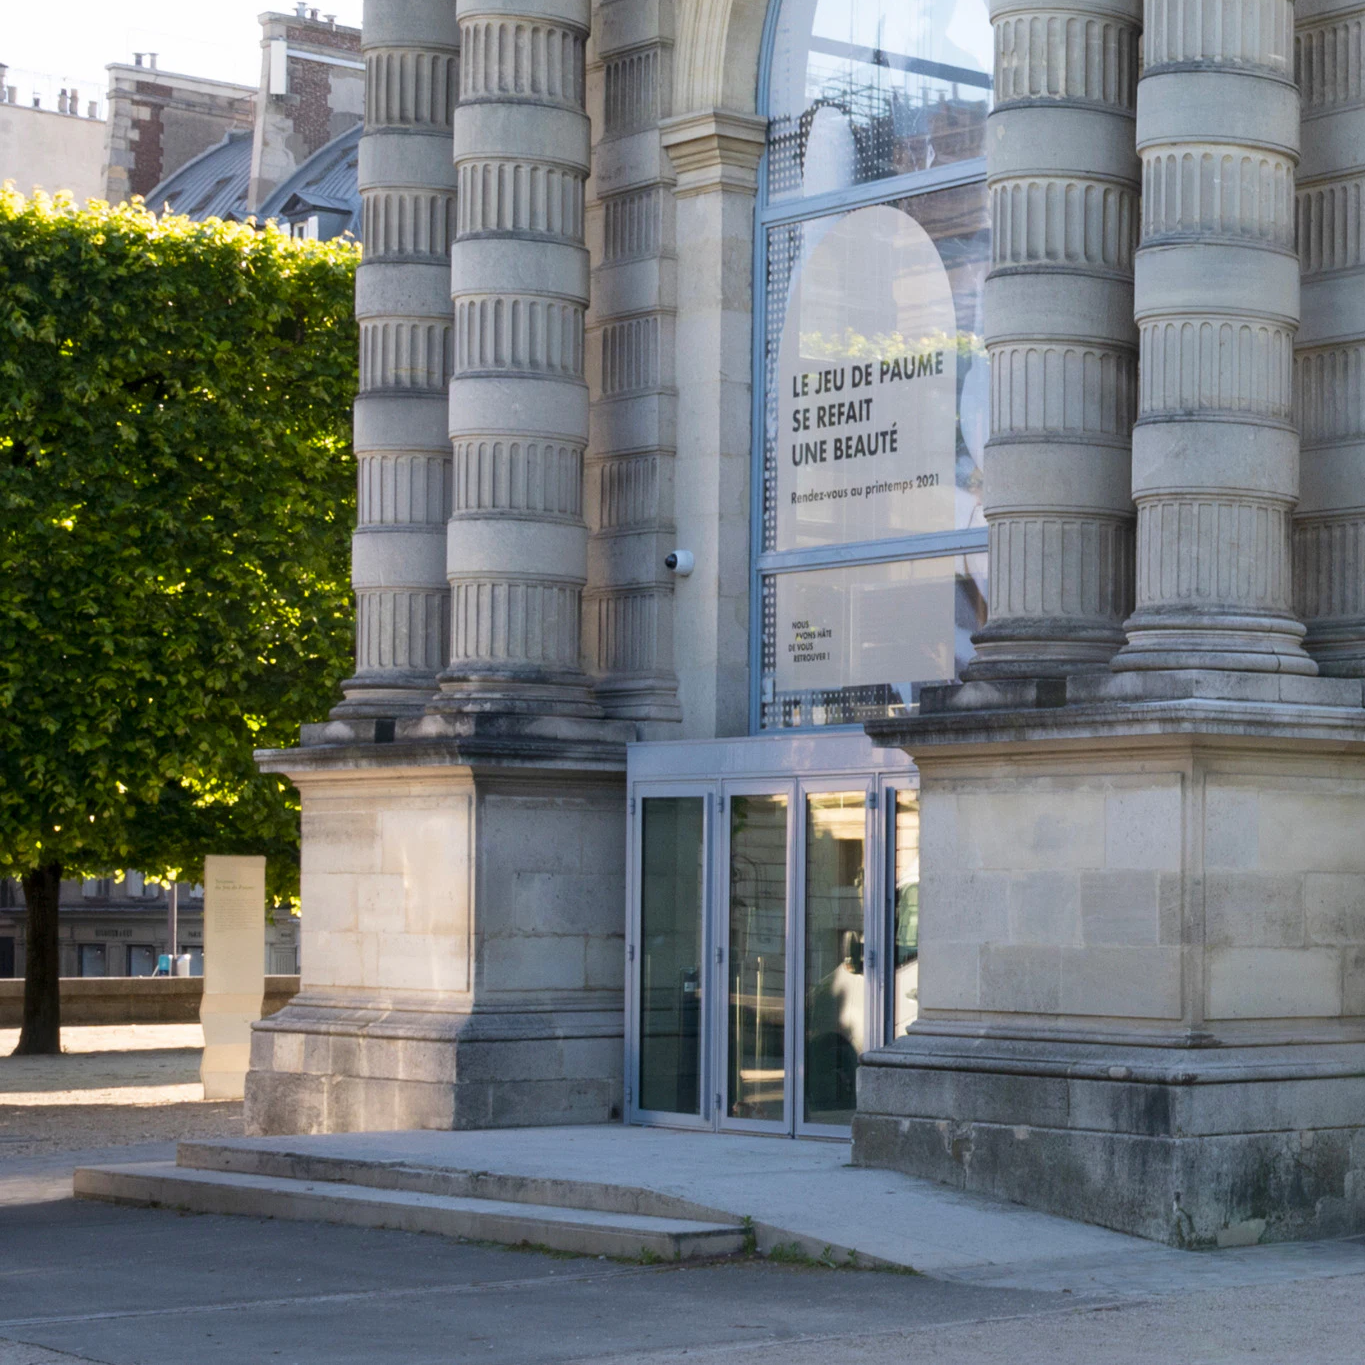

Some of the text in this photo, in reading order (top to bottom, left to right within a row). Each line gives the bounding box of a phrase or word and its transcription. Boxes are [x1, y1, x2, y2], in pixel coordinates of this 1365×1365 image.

[792, 351, 944, 398] LE JEU DE PAUME
[792, 398, 873, 433] SE REFAIT
[791, 422, 898, 467] UNE BEAUTÉ
[791, 473, 940, 505] Rendez-vous au printemps 2021
[792, 621, 809, 629] NOUS
[788, 642, 814, 652] DE VOUS
